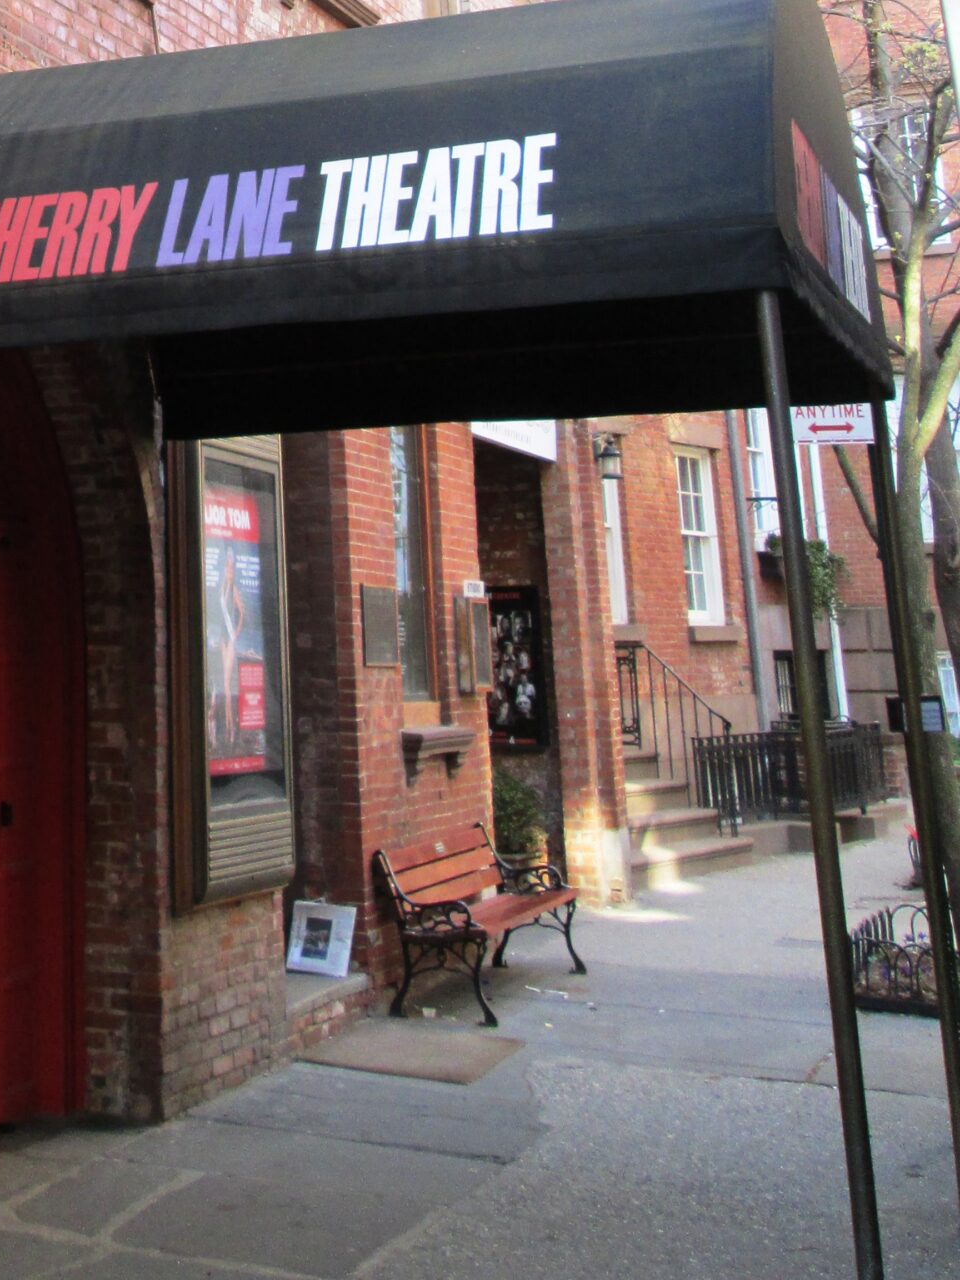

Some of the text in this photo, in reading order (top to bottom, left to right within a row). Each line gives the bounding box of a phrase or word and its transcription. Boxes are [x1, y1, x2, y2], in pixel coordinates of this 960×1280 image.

[156, 164, 305, 267] LANE
[315, 133, 556, 251] THEATRE
[795, 403, 864, 418] ANYTIME
[227, 507, 251, 530] TOM
